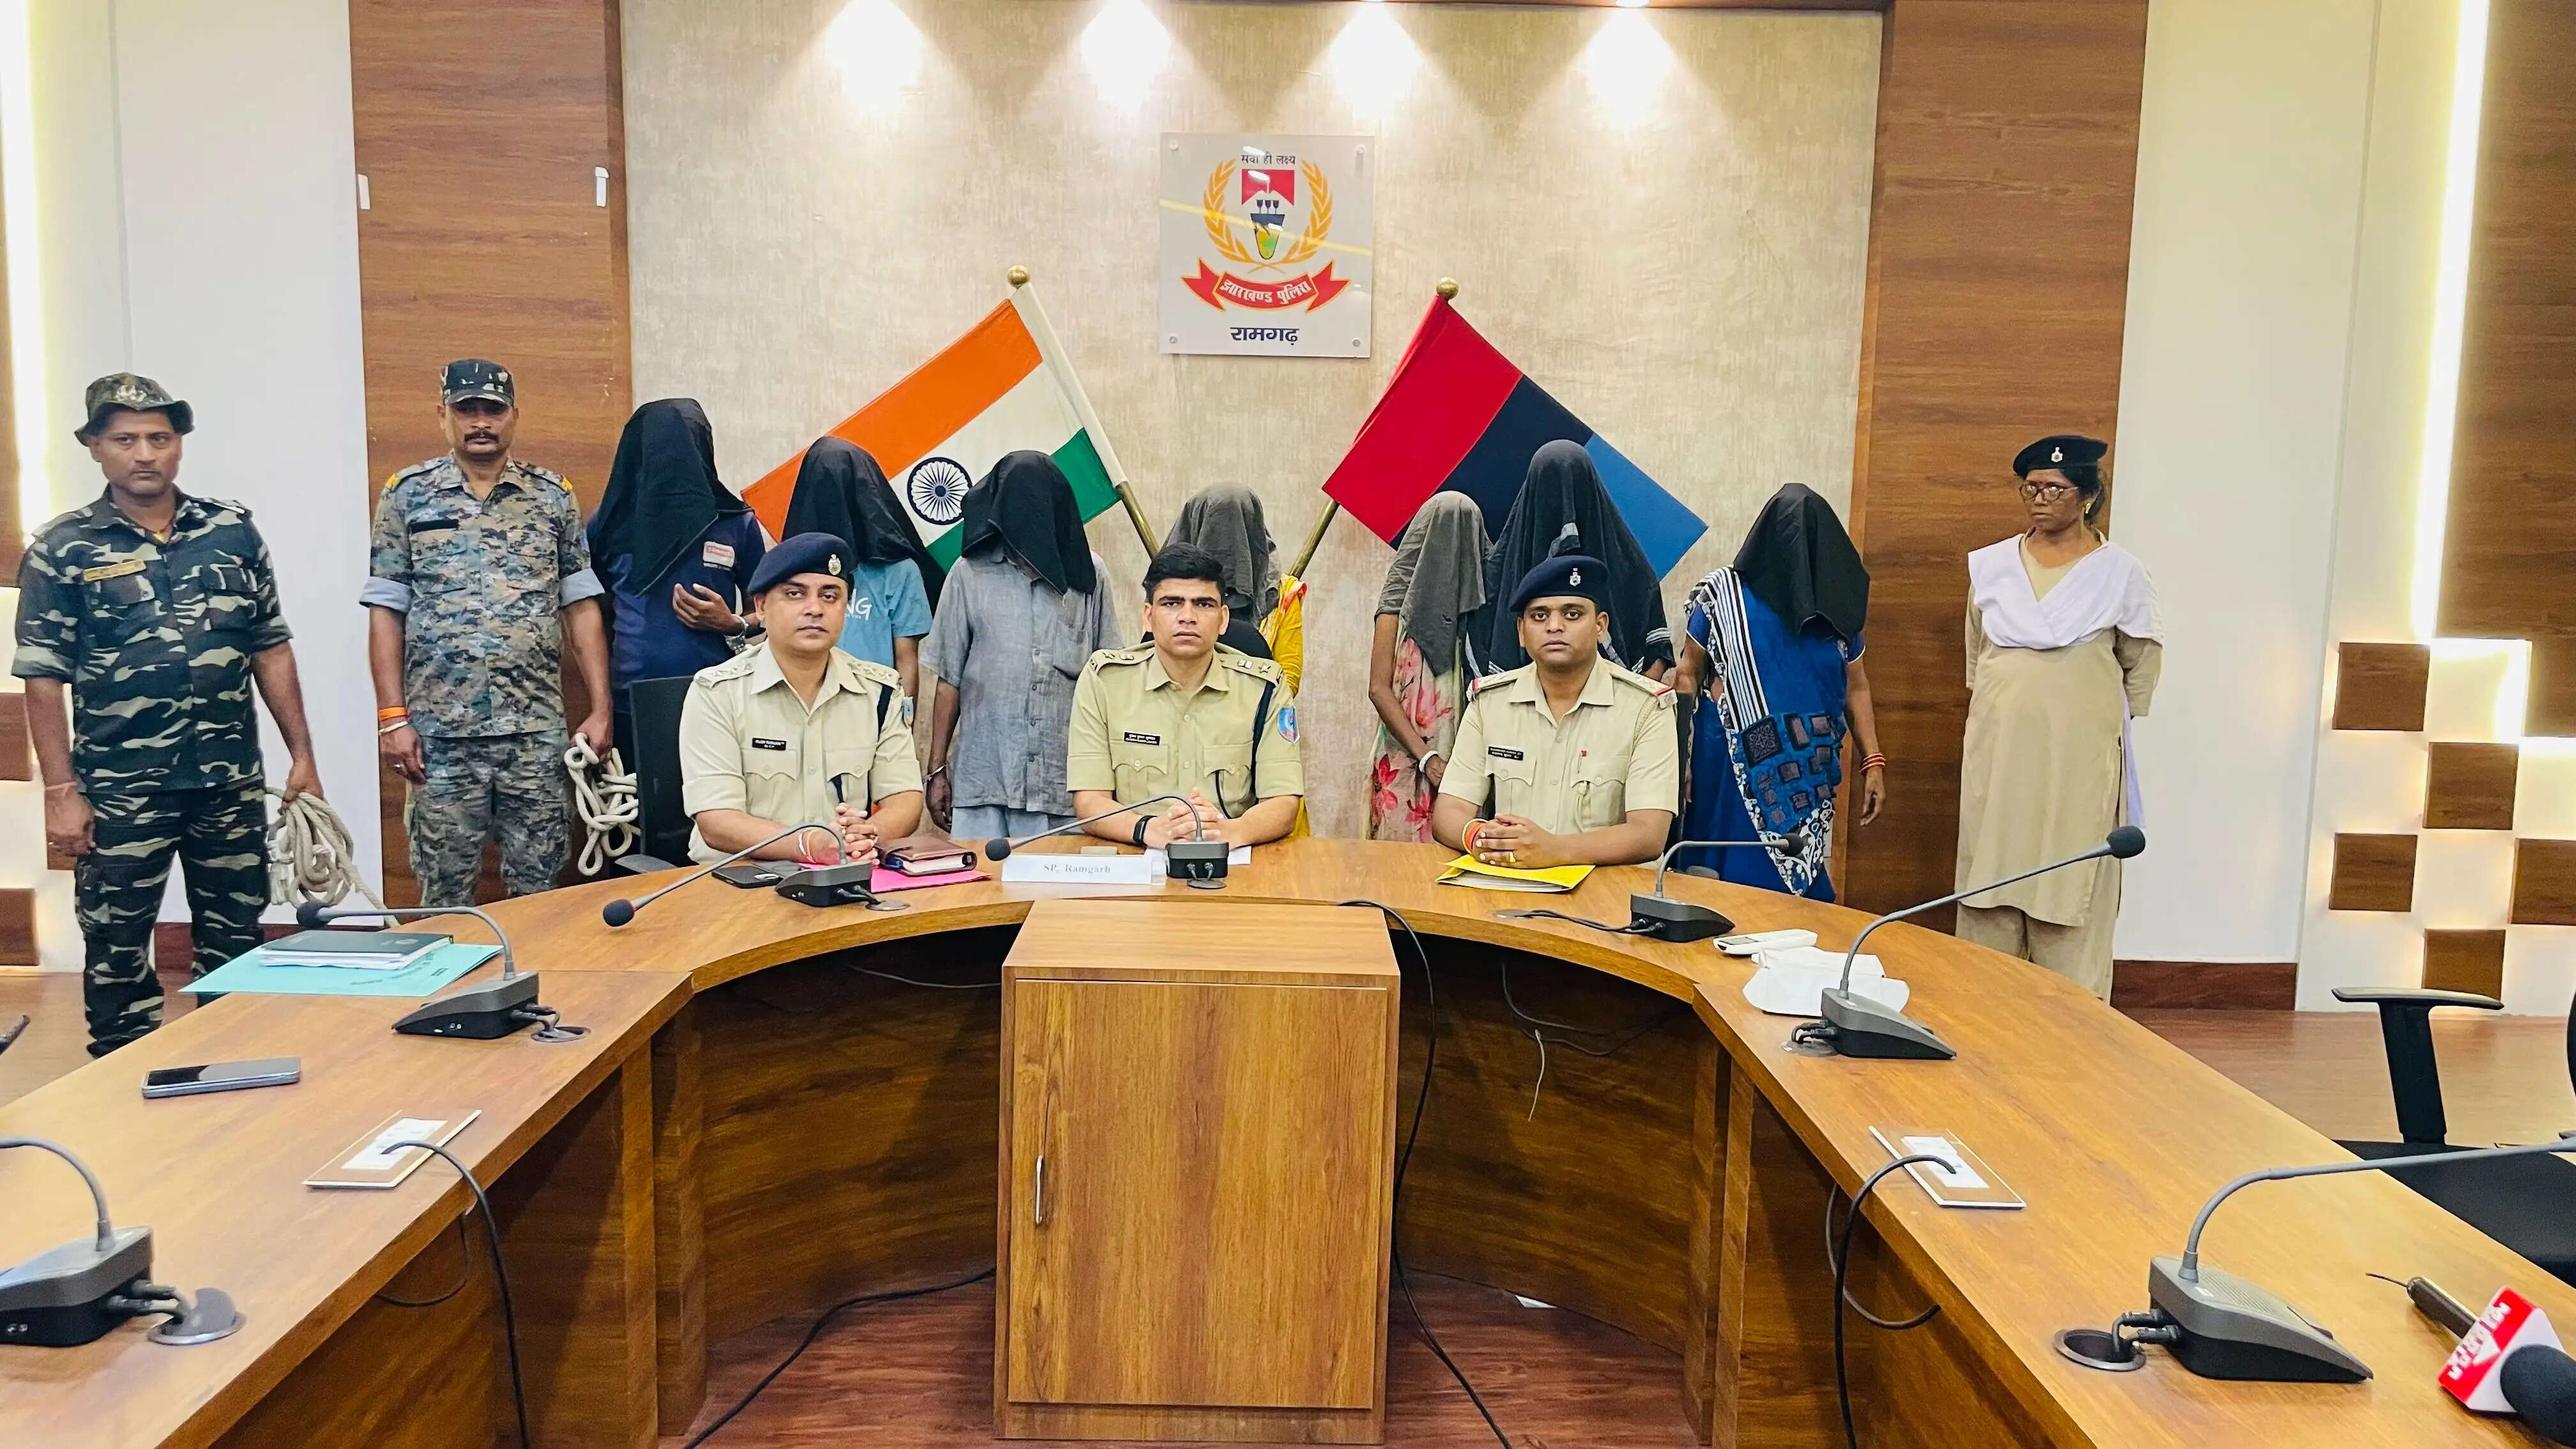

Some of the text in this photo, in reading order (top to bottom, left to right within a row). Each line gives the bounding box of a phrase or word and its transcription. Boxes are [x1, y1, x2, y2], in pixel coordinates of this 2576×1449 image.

[1241, 154, 1259, 164] सवा
[1275, 155, 1296, 165] लक्ष्य
[1220, 279, 1312, 305] झारखण्ड पुलिस
[1230, 326, 1300, 346] रामगढ़
[1065, 864, 1111, 874] Ramgarh
